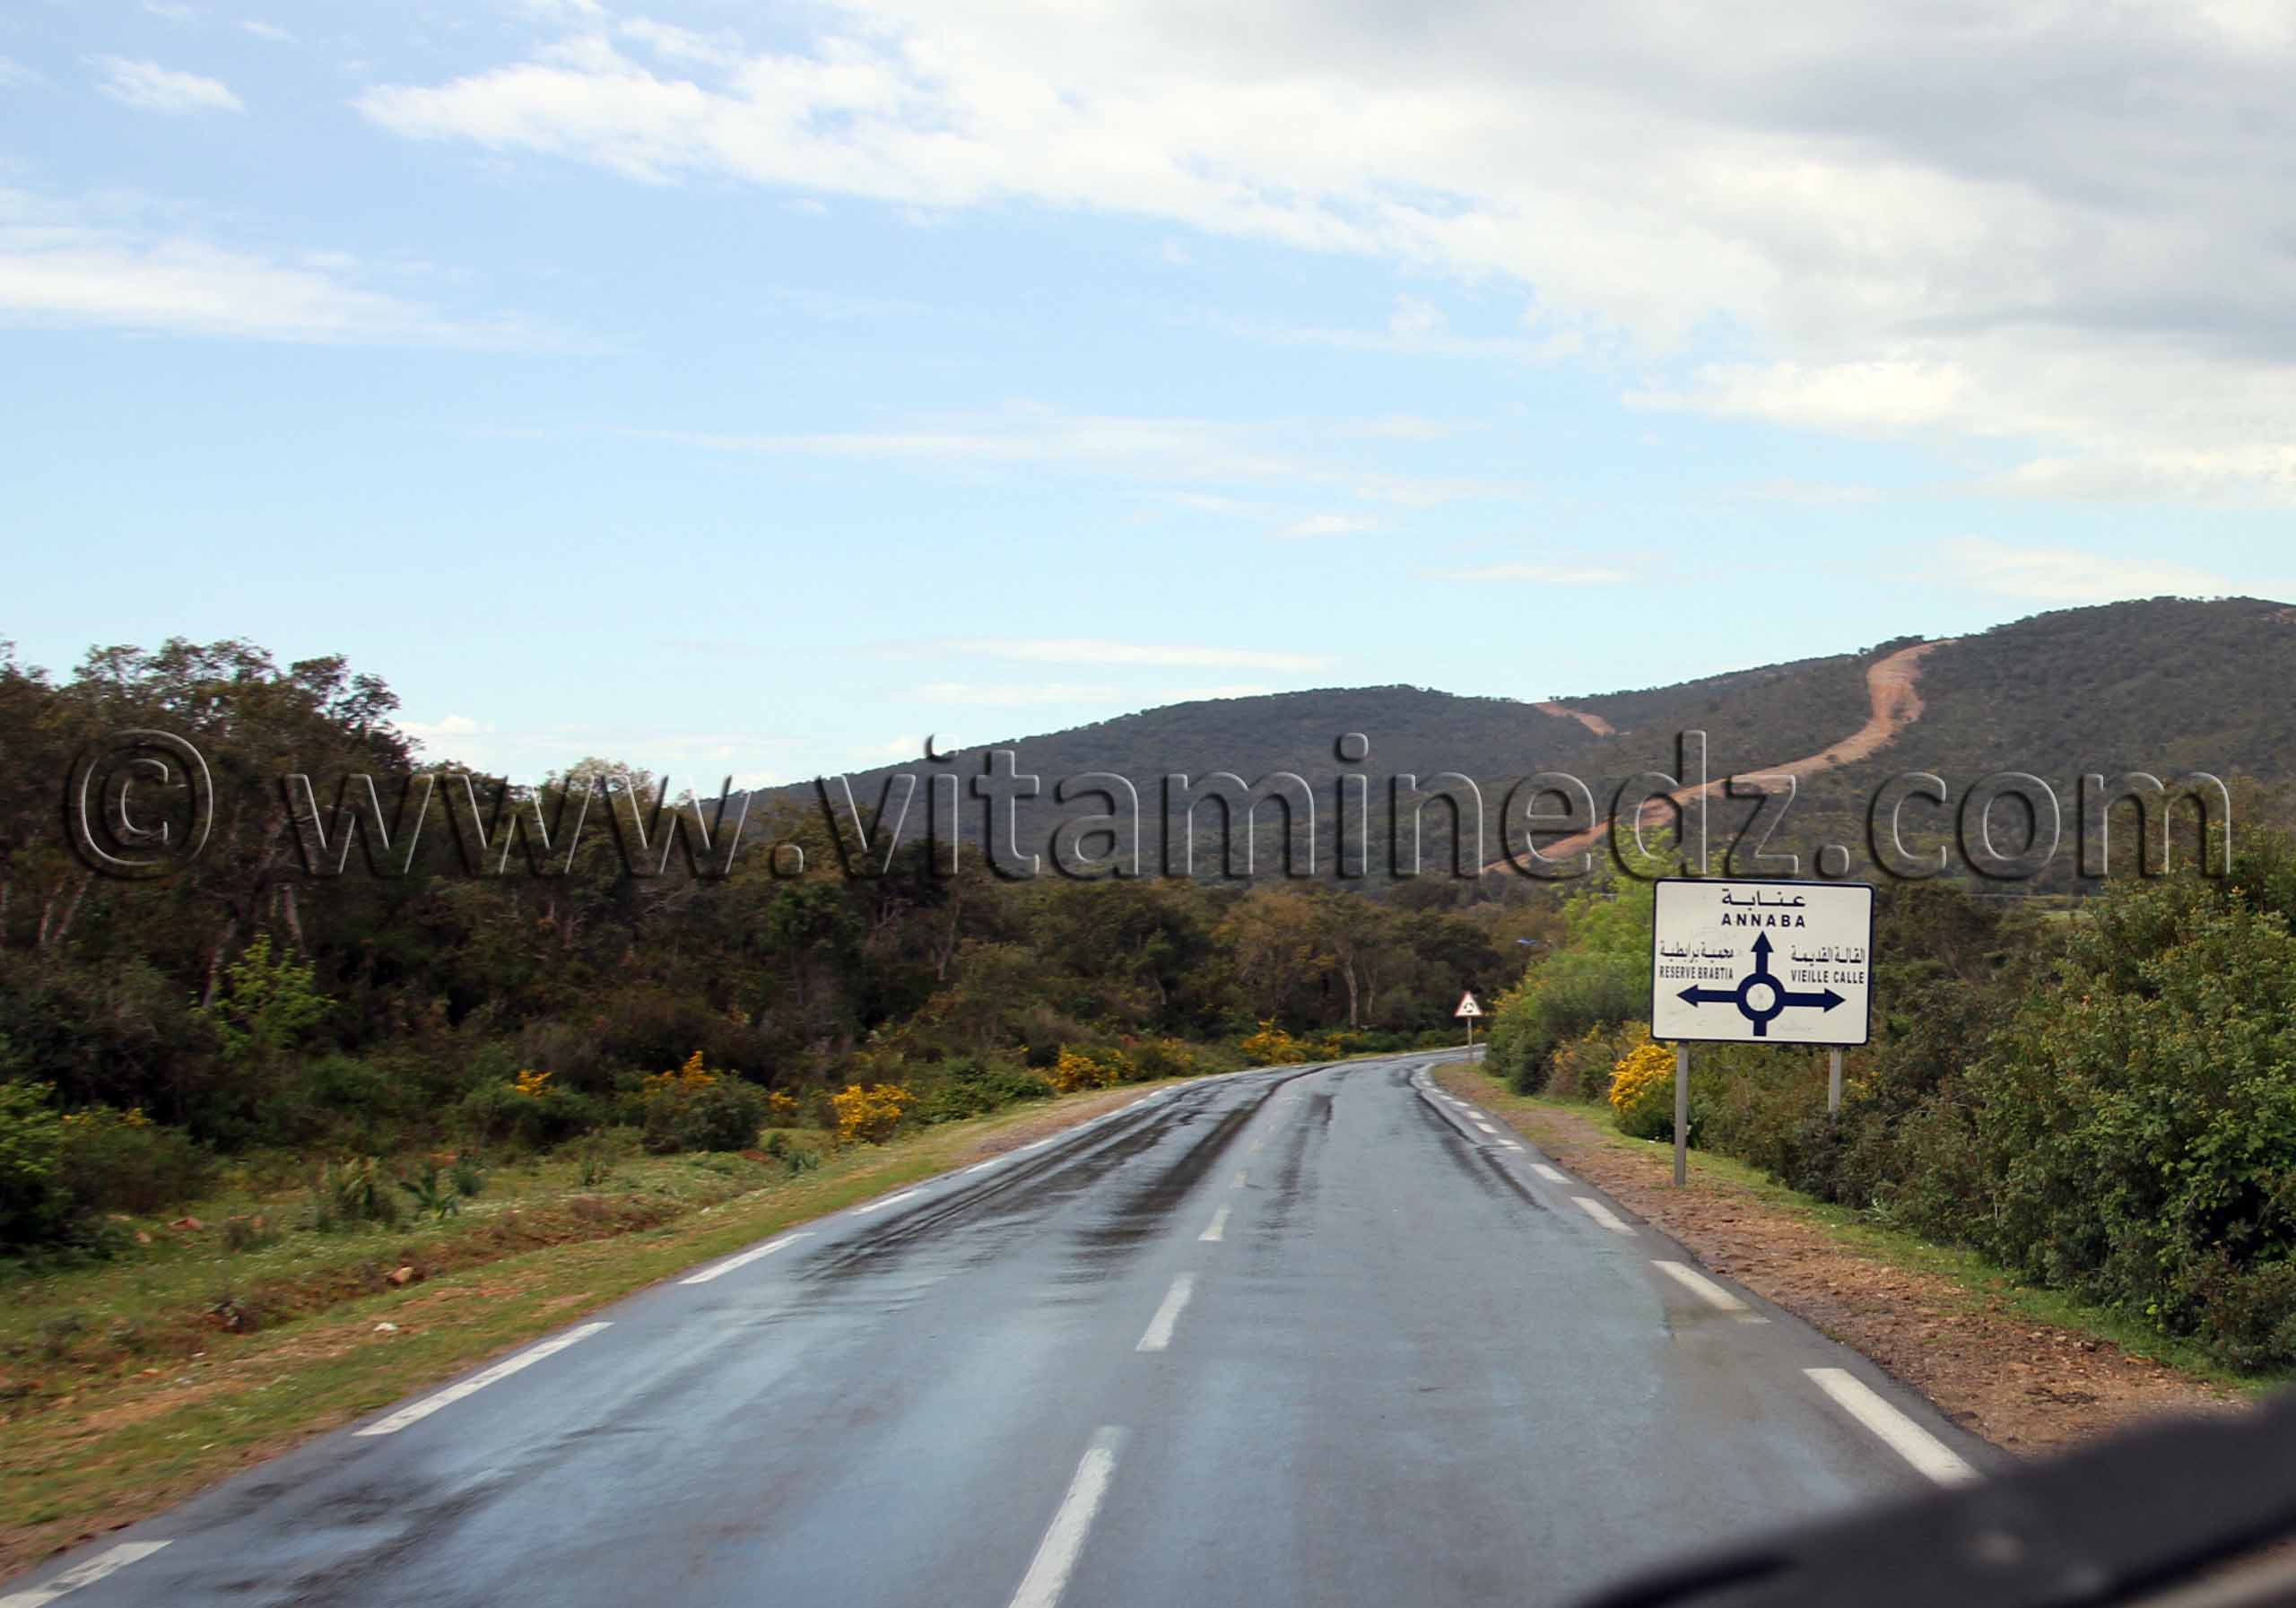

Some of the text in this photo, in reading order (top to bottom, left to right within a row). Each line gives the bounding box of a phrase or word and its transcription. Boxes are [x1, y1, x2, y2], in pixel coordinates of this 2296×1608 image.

[1721, 888, 1806, 911] عنابة
[1721, 913, 1805, 928] ANNABA
[1790, 944, 1866, 967] القالة القديمة
[1659, 965, 1734, 980] RESERVE BRABTIA
[1790, 969, 1865, 985] VIEILLE CALLE
